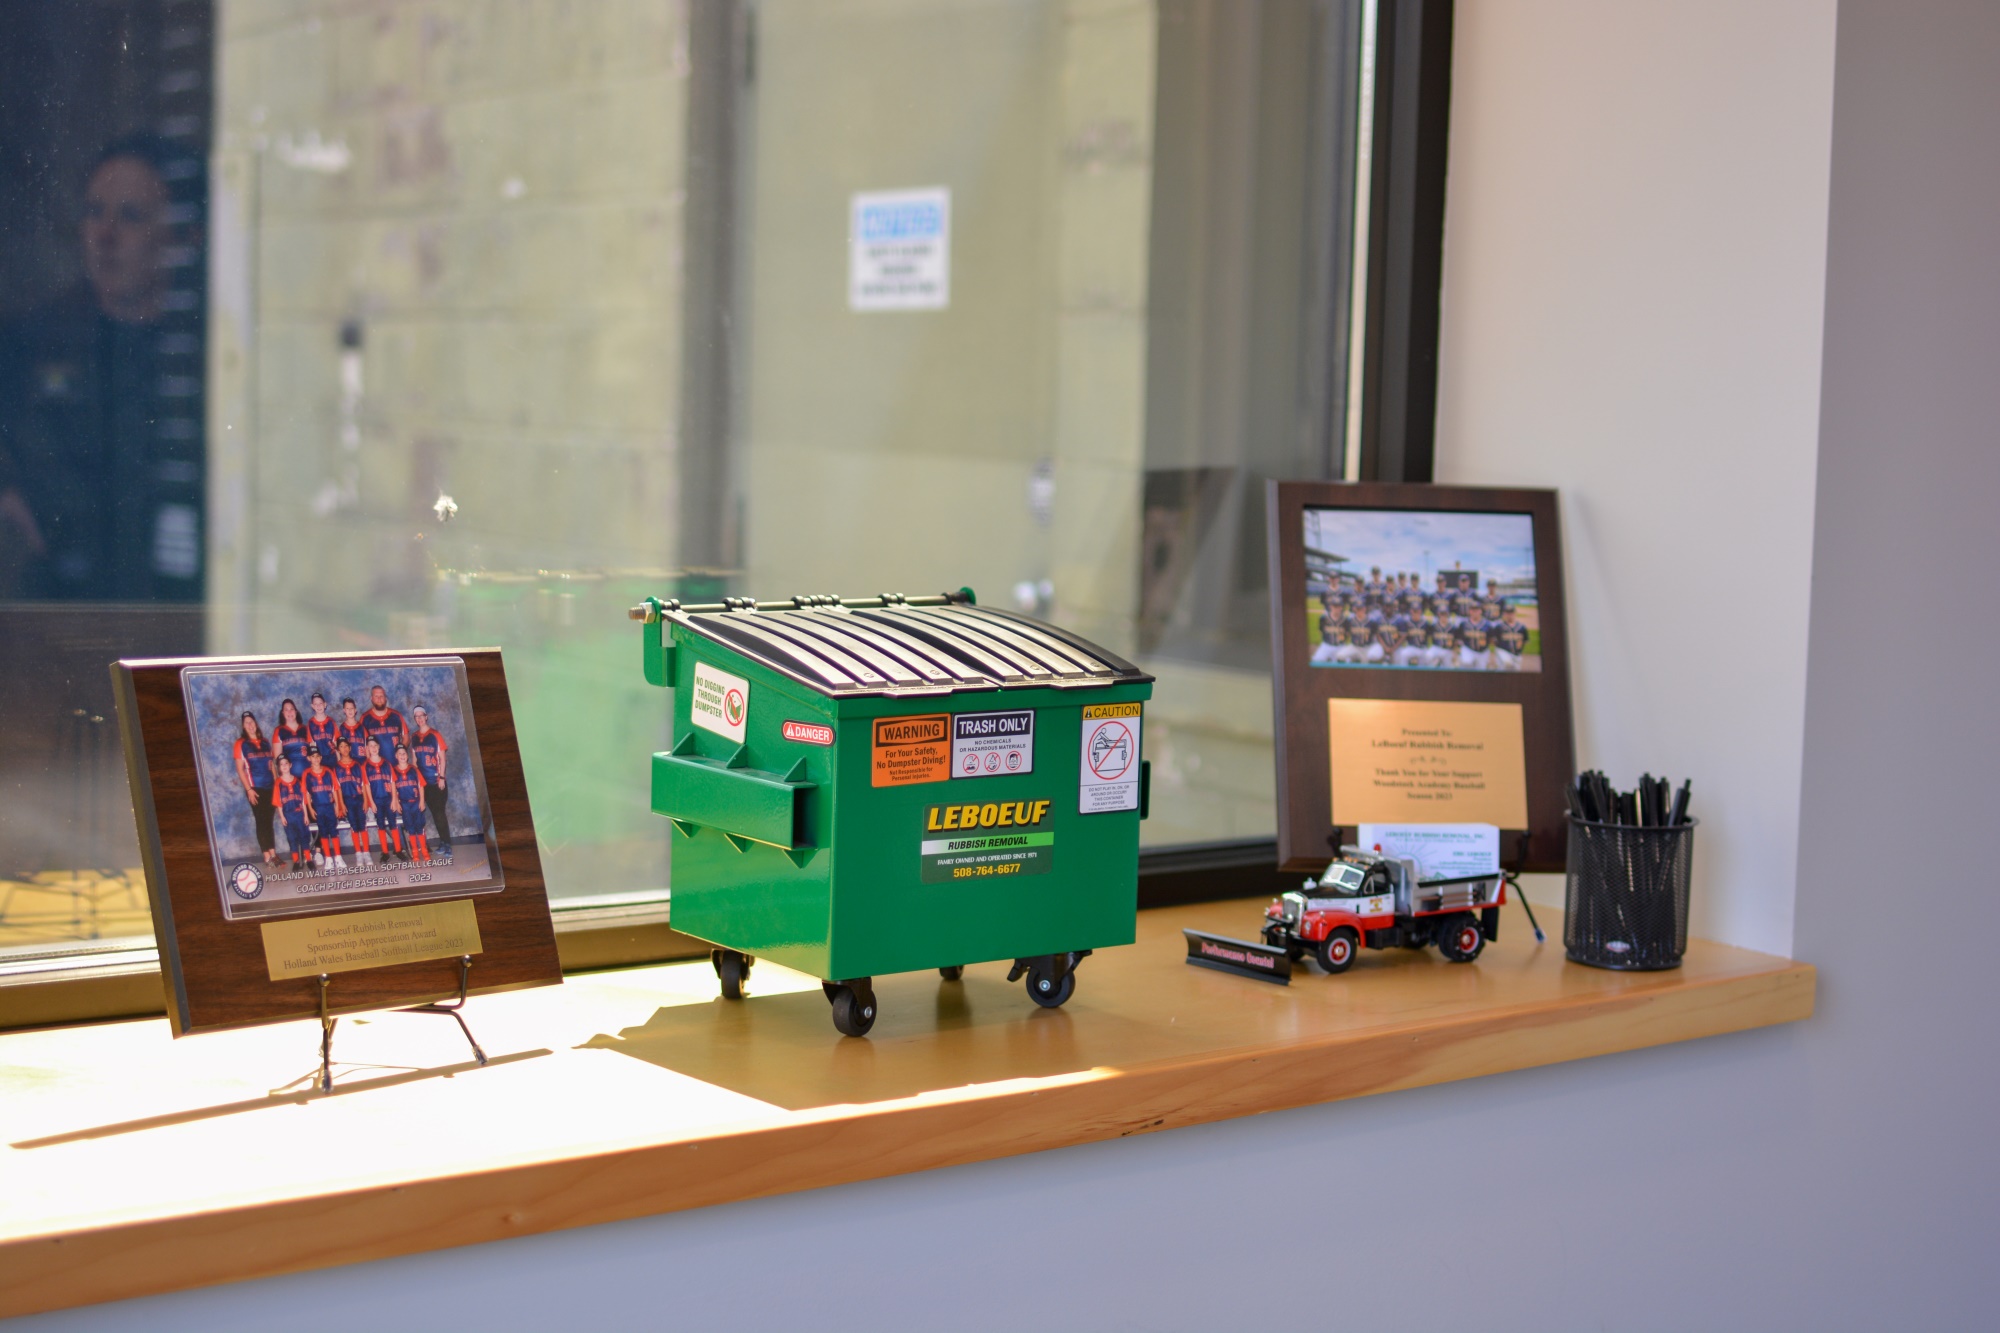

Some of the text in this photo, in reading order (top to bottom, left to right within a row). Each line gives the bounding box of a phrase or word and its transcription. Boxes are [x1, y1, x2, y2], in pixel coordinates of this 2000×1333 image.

[696, 676, 725, 695] NO DIGGING
[698, 689, 721, 706] THROUGH
[695, 700, 722, 718] DUMPSTER
[1094, 706, 1139, 718] CAUTION
[796, 726, 830, 742] DANGER
[884, 724, 940, 740] WARNING
[960, 718, 1028, 734] TRASH ONLY
[886, 750, 896, 758] For
[915, 747, 937, 755] Safety,
[877, 755, 946, 769] No Dumpster Diving!
[928, 801, 1050, 832] LEBOEUF
[948, 836, 1028, 850] RUBBISH REMOVAL
[265, 871, 304, 882] HOLLAND
[306, 868, 335, 878] WALES
[338, 864, 379, 876] BASEBALL
[381, 861, 421, 872] SOFTBALL
[423, 858, 453, 867] LEAGUE
[953, 864, 1020, 877] 508-764-6677
[296, 873, 431, 893] COACH PITCH BASEBALL 2023
[317, 917, 423, 938] Leboeuf Rubbish Removal
[307, 928, 437, 954] Sponsorship Appreciation Award
[284, 938, 464, 970] Holland Wales Baseball Softball League 2023
